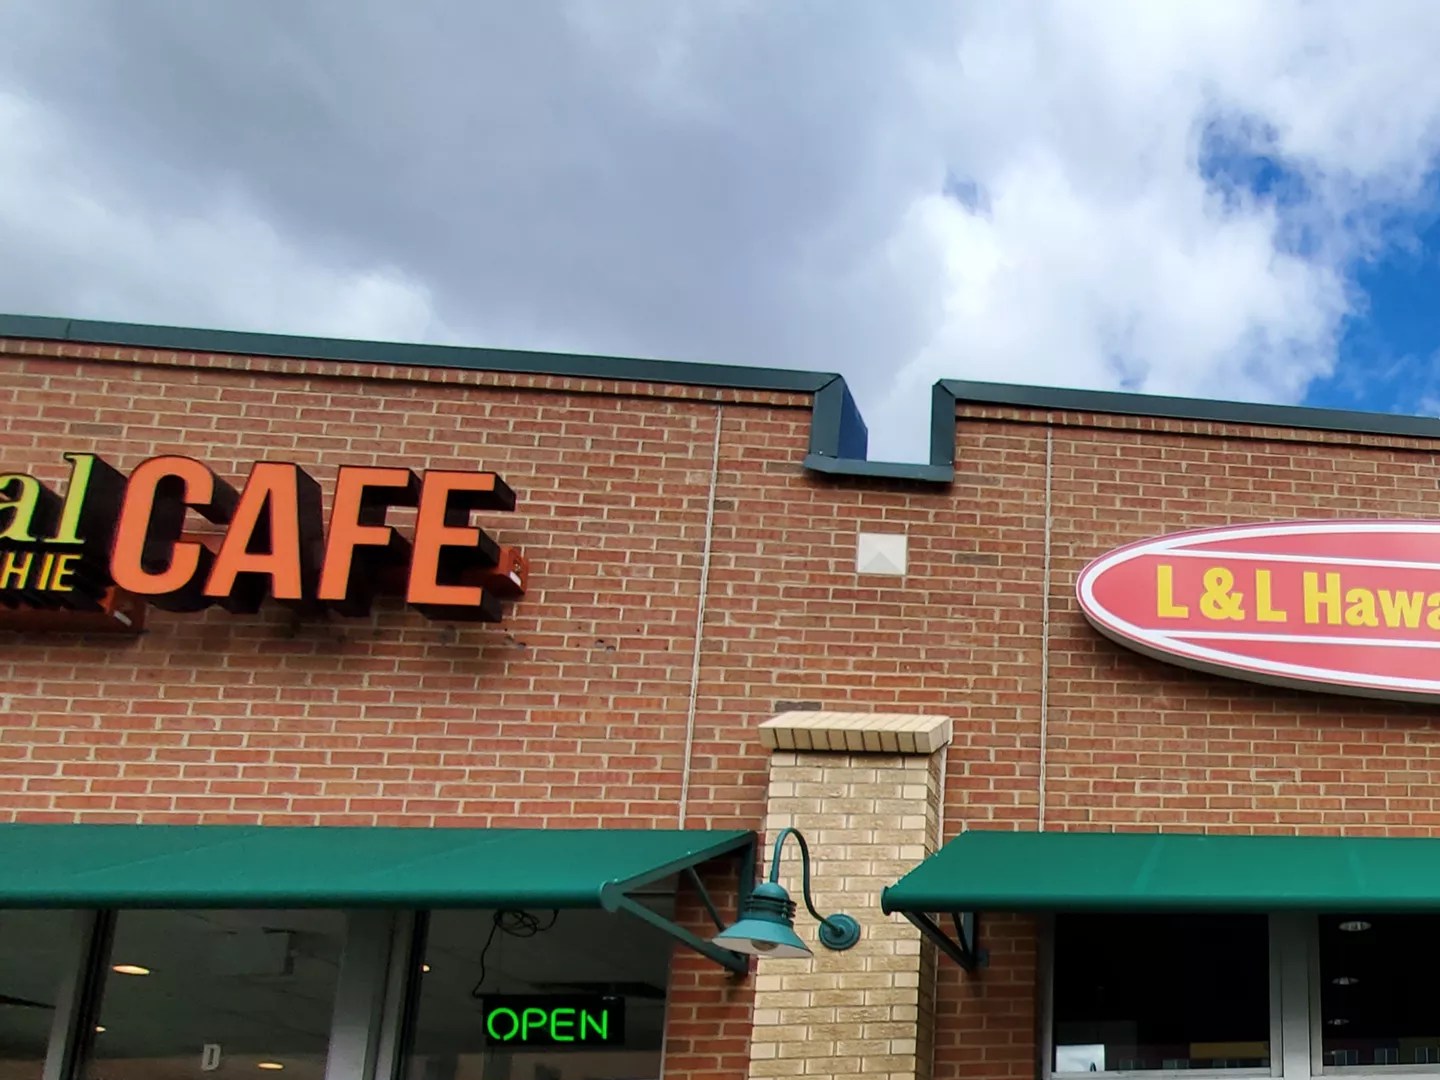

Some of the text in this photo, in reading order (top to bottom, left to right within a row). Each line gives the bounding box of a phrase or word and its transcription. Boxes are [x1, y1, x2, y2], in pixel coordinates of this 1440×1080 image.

[110, 454, 496, 606] CAFE
[487, 1007, 608, 1041] OPEN
[201, 1043, 220, 1070] D
